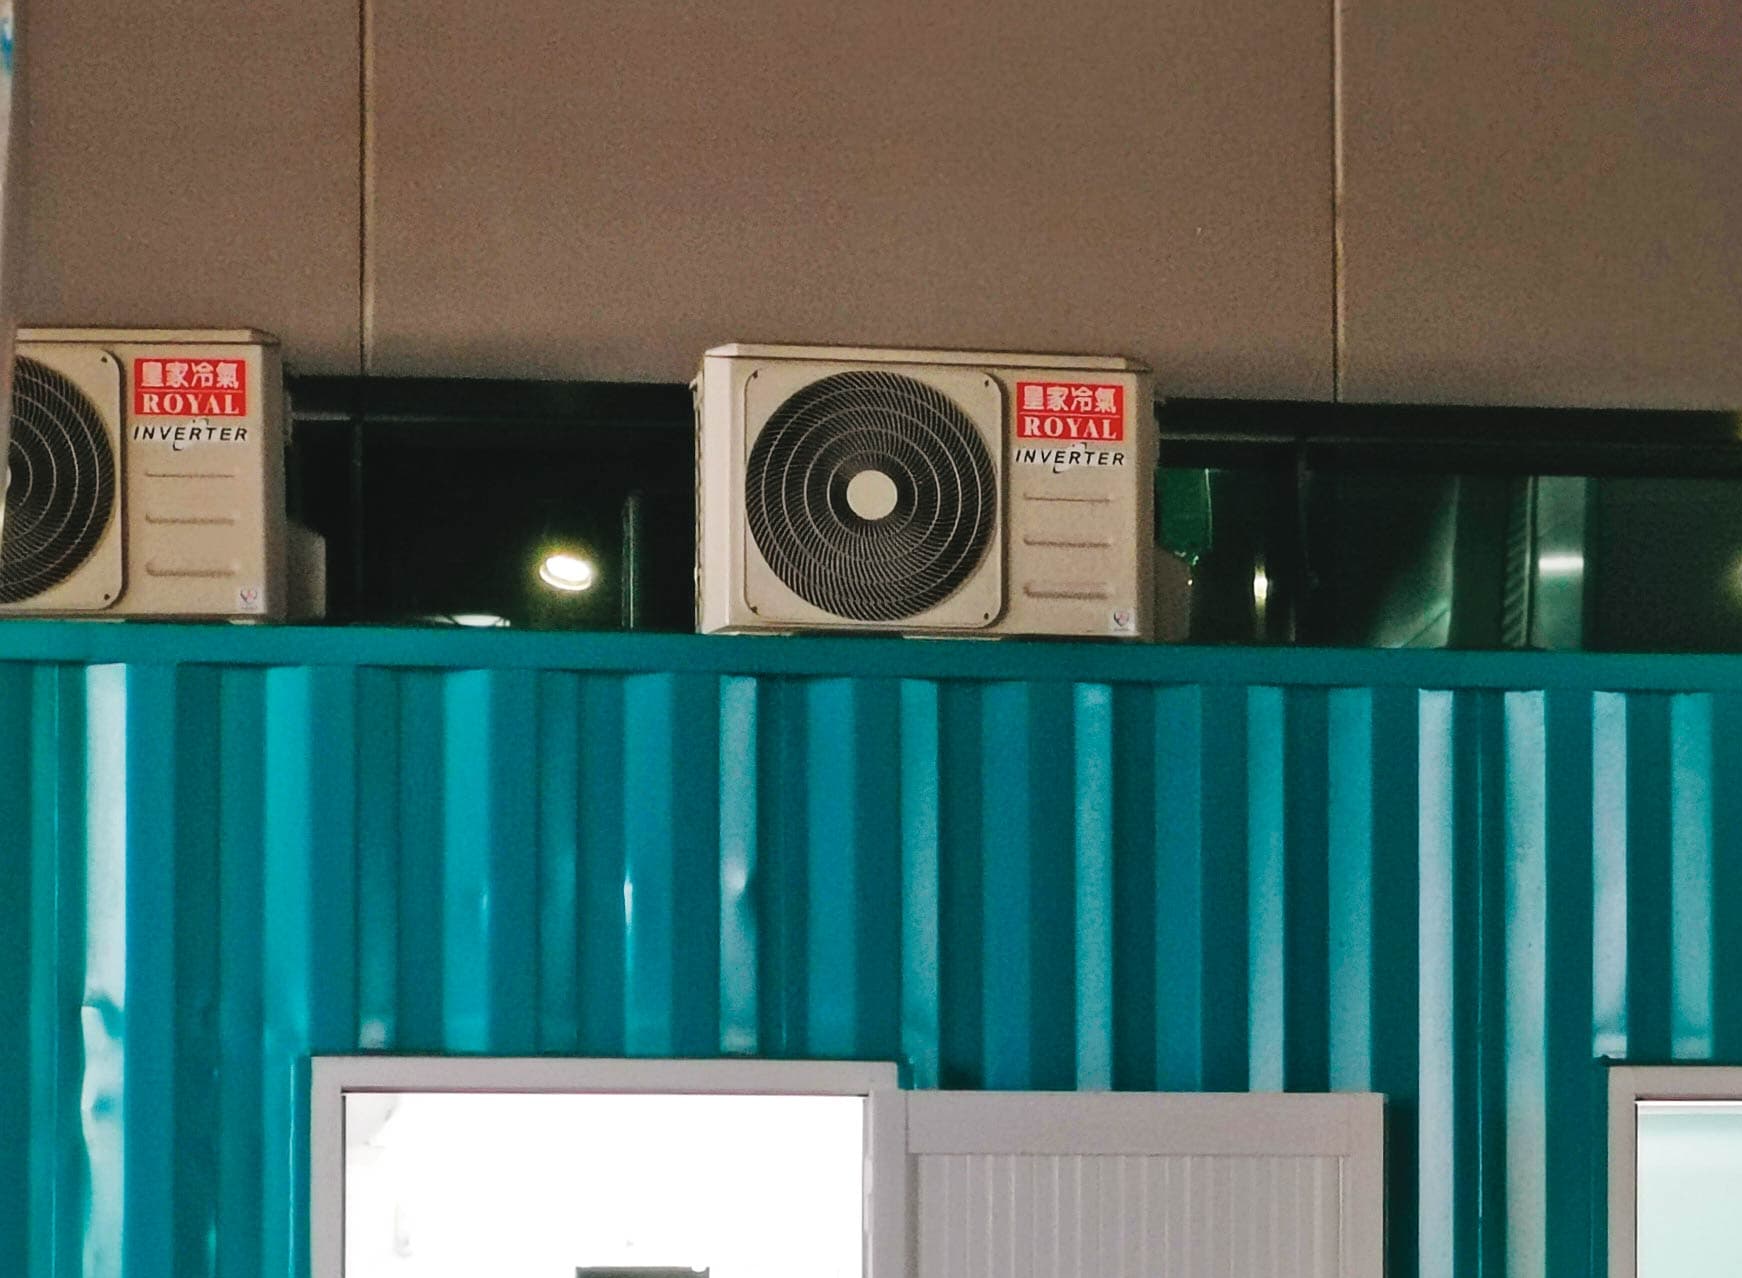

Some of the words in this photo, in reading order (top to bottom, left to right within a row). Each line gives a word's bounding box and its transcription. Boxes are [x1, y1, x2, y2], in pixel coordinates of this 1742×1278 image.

[142, 393, 239, 414] ROYAL
[133, 426, 248, 441] INVERTER
[1024, 416, 1117, 439] ROYAL
[1016, 449, 1125, 466] INVERTER
